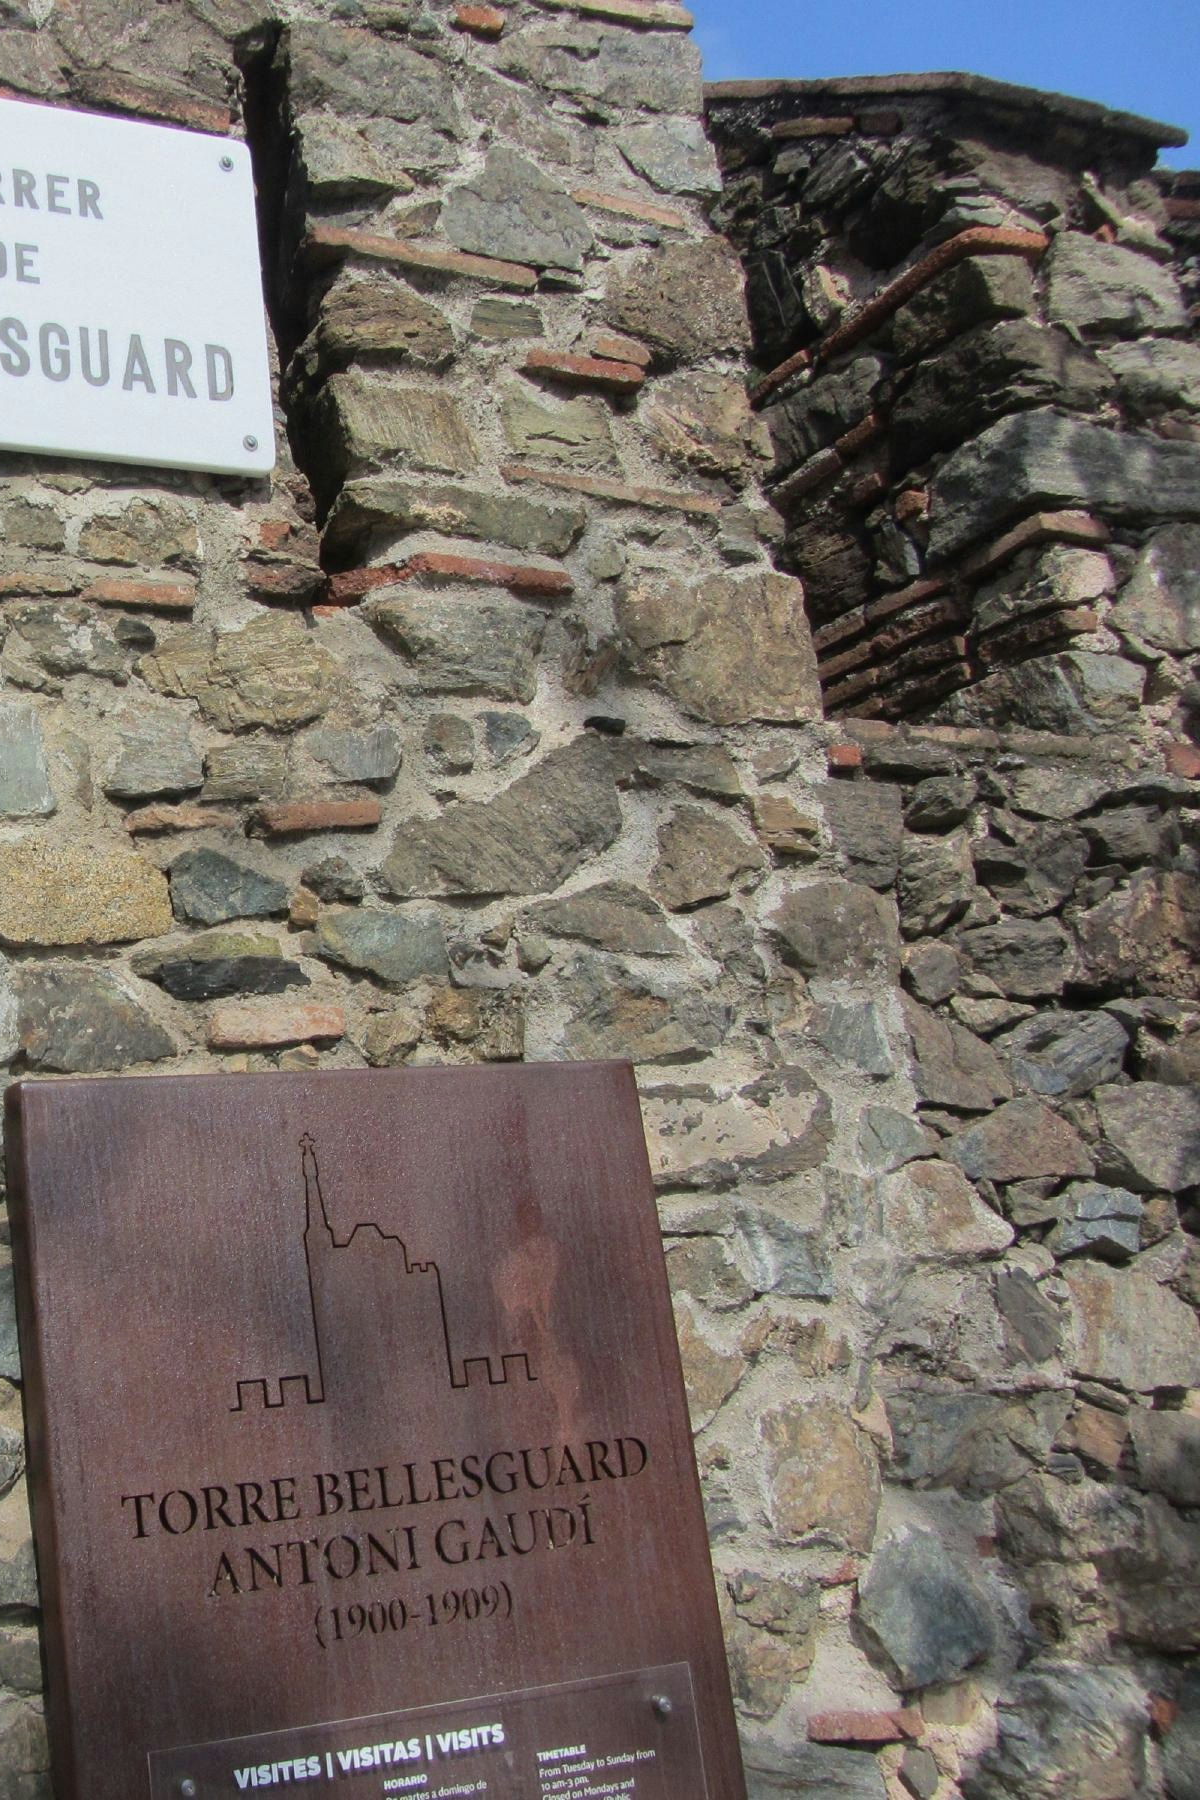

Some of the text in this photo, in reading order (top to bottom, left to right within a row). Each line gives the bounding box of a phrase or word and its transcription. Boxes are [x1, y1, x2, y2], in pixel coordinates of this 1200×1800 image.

[121, 1436, 648, 1539] TORRE BELLESGUARD
[207, 1493, 597, 1598] ANTONI GAUDÍ
[313, 1581, 513, 1649] (1900-1909)
[234, 1723, 505, 1789] VISITES VISITAS VISITS
[536, 1744, 586, 1762] TIMETABLE
[539, 1749, 656, 1778] From Tuesday to Sunday from
[383, 1774, 428, 1790] HORARIO
[438, 1783, 475, 1797] domingo
[476, 1779, 487, 1790] de
[571, 1790, 583, 1799] on
[583, 1783, 619, 1797] Mondays
[620, 1777, 635, 1789] and
